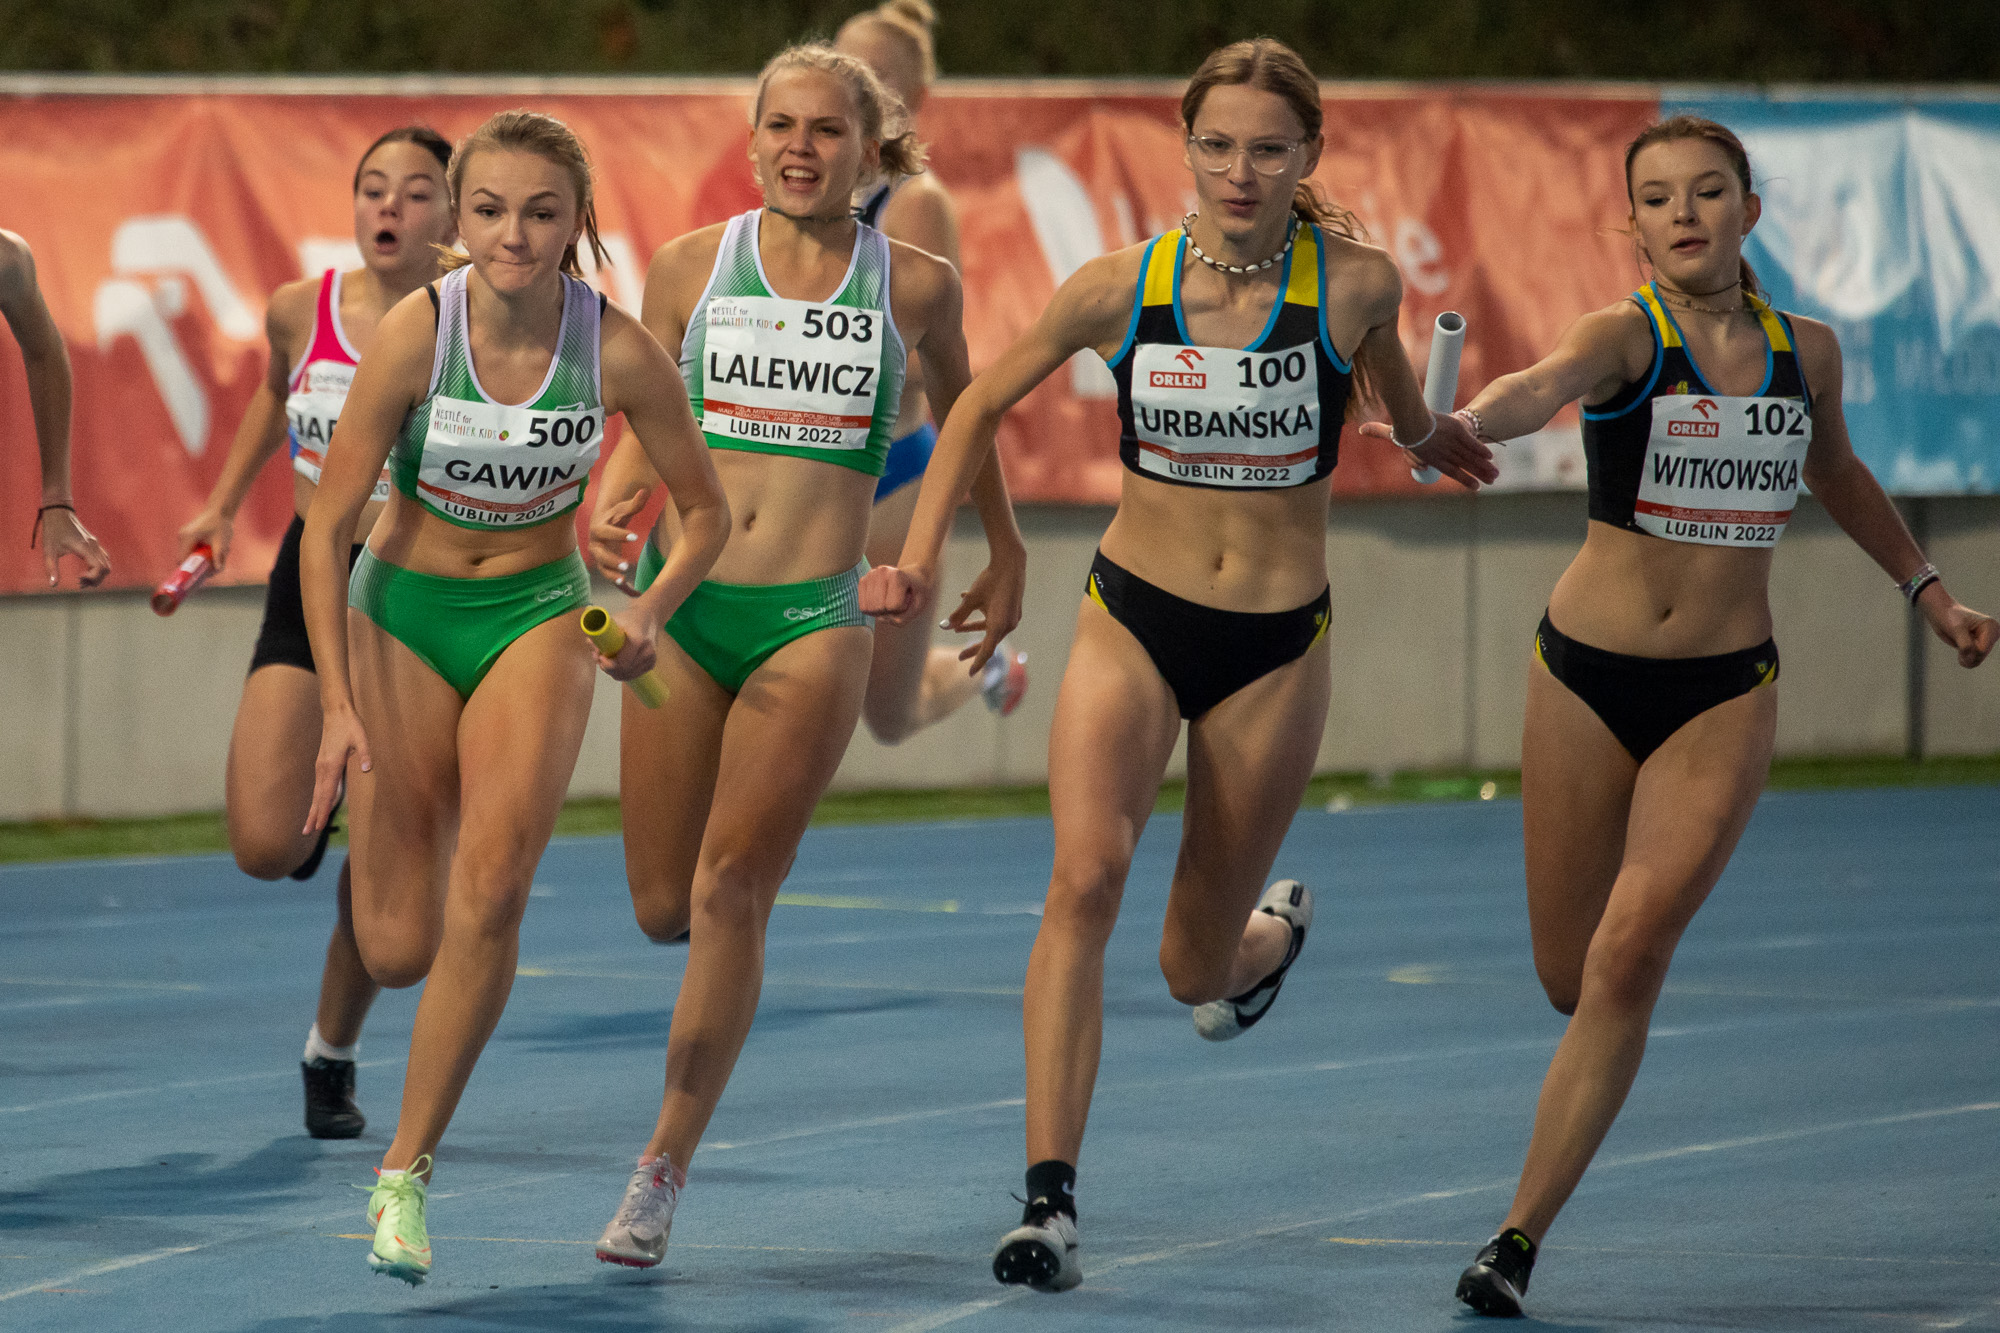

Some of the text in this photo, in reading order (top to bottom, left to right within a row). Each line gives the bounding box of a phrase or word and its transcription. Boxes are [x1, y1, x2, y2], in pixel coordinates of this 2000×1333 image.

[756, 319, 773, 329] KIDS
[802, 308, 873, 343] 503
[710, 352, 875, 397] LALEWICZ
[1152, 375, 1203, 387] ORLEN
[1237, 351, 1306, 389] 100
[526, 415, 596, 448] 500
[730, 419, 842, 444] LUBLIN 2022
[1140, 404, 1314, 439] URBAŃSKA
[1670, 423, 1717, 436] ORLEN
[1745, 403, 1804, 436] 102
[478, 428, 497, 440] KIDS
[444, 459, 577, 491] GAWIN
[1169, 462, 1291, 481] LUBLIN 2022
[1653, 453, 1798, 492] WITKOWSKA
[444, 500, 555, 523] LUBLIN 2022
[1665, 520, 1776, 541] LUBLIN 2022
